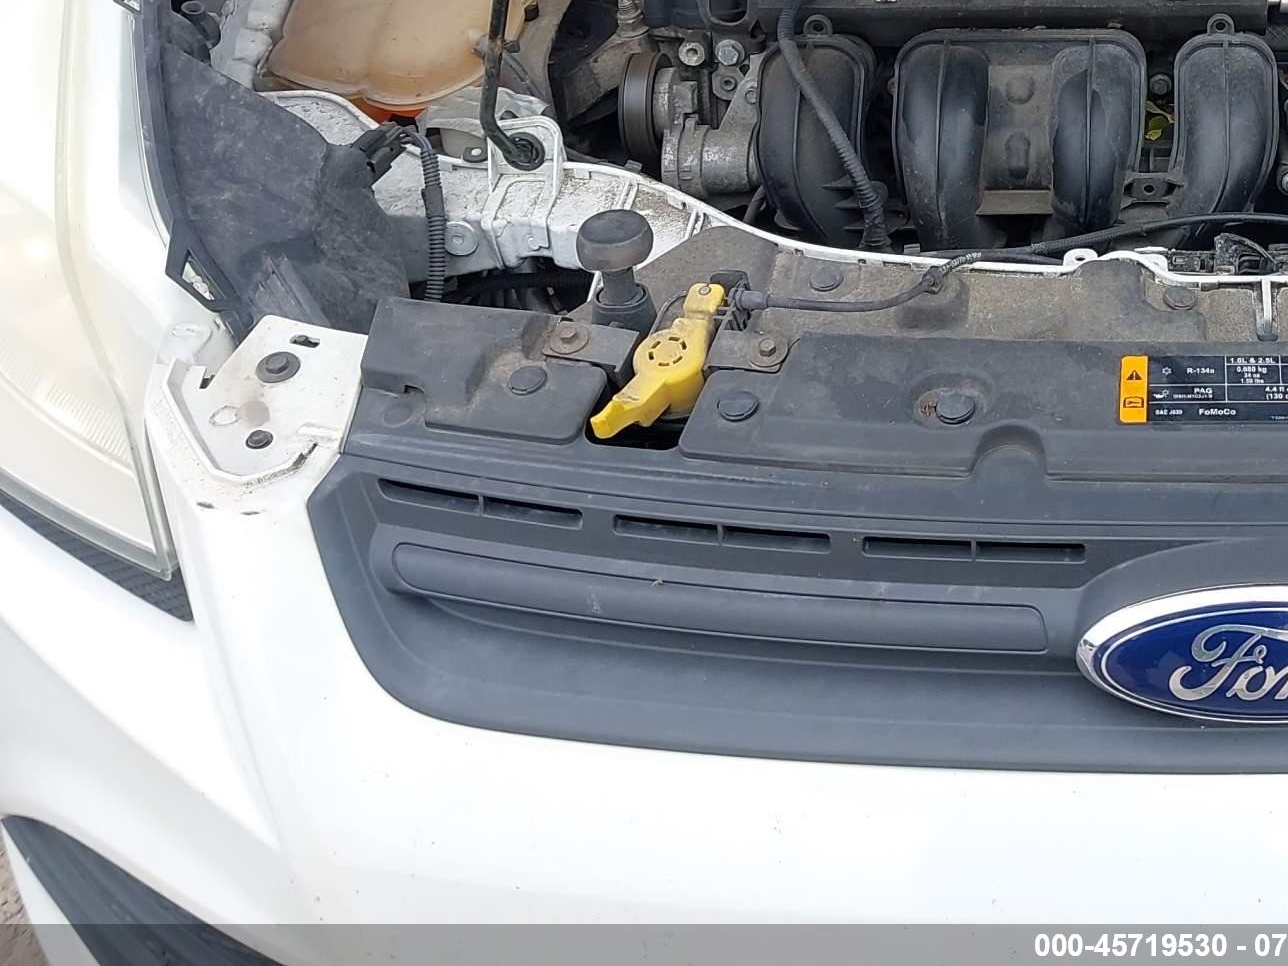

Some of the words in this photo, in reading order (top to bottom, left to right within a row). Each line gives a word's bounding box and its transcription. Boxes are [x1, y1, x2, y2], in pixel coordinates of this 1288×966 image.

[1258, 366, 1268, 374] kg
[1266, 393, 1283, 401] (130
[1199, 408, 1237, 416] FoMoCo
